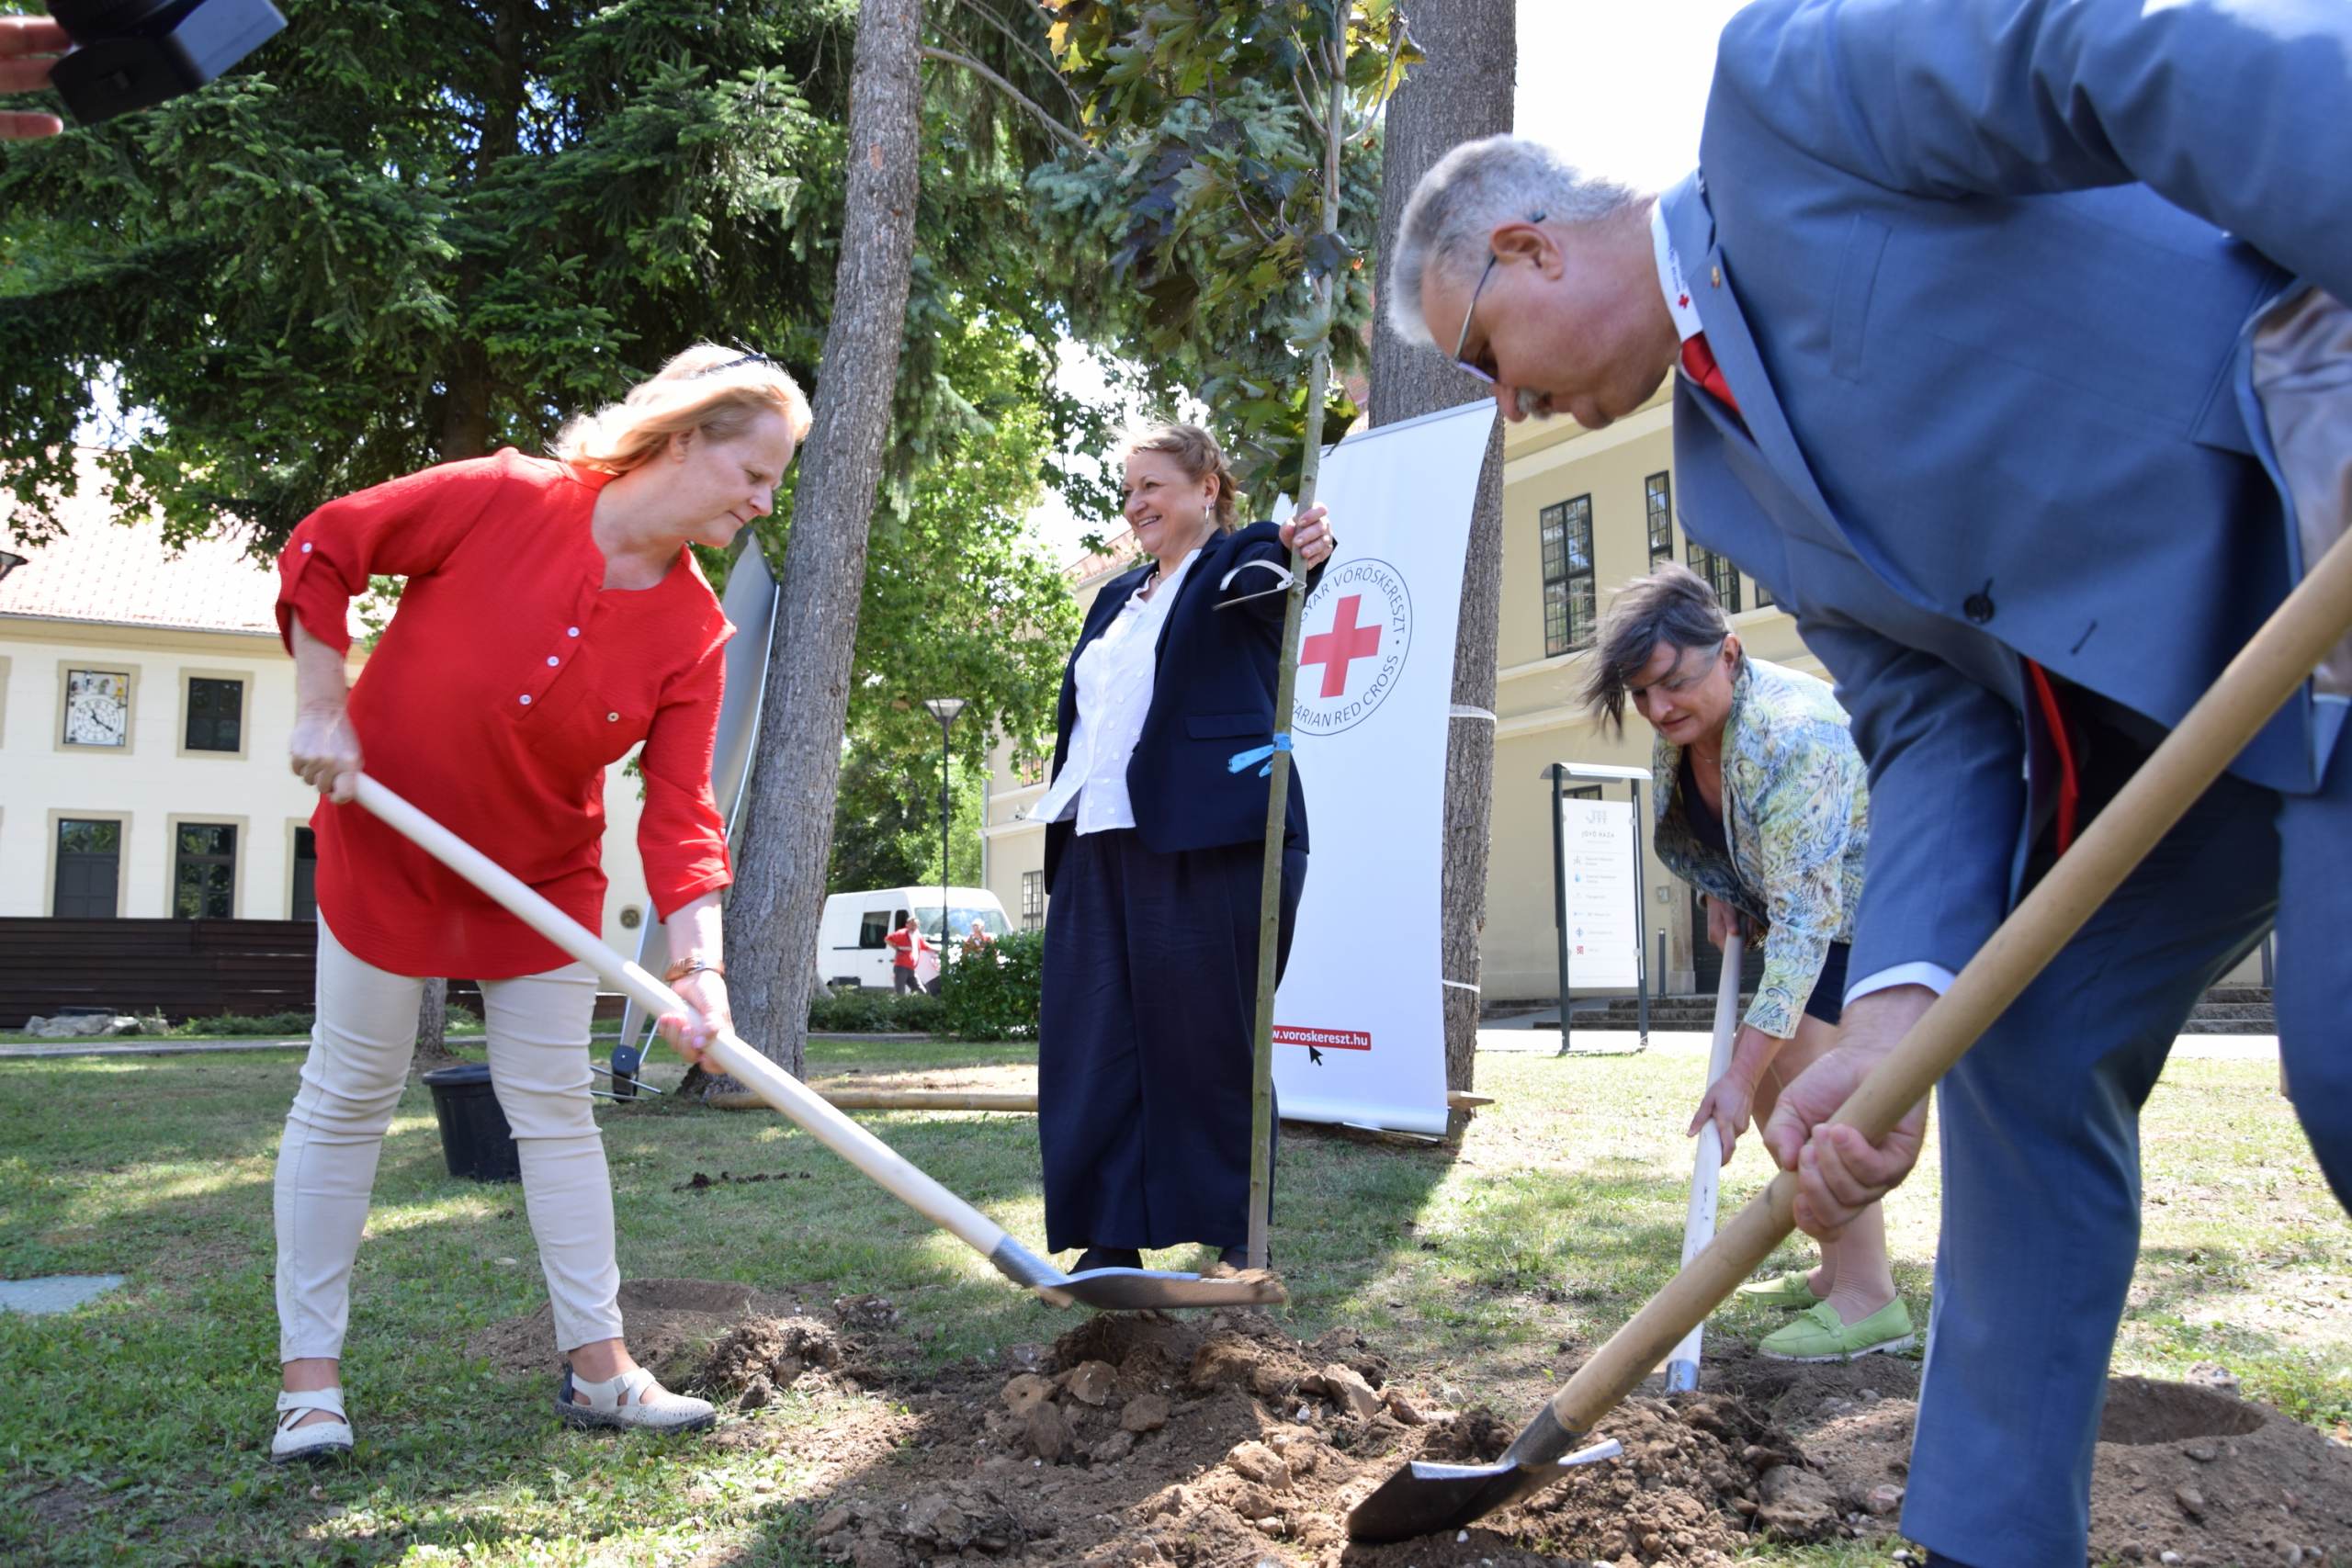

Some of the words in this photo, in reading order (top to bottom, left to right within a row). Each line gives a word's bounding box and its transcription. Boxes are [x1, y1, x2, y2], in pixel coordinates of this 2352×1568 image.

[1300, 582, 1330, 625] GYAR
[1333, 564, 1406, 634] VÖRÖSKERESZT
[1334, 702, 1362, 725] RED
[1363, 655, 1399, 705] CROSS
[1272, 1030, 1369, 1046] w.voroskereszt.hu
